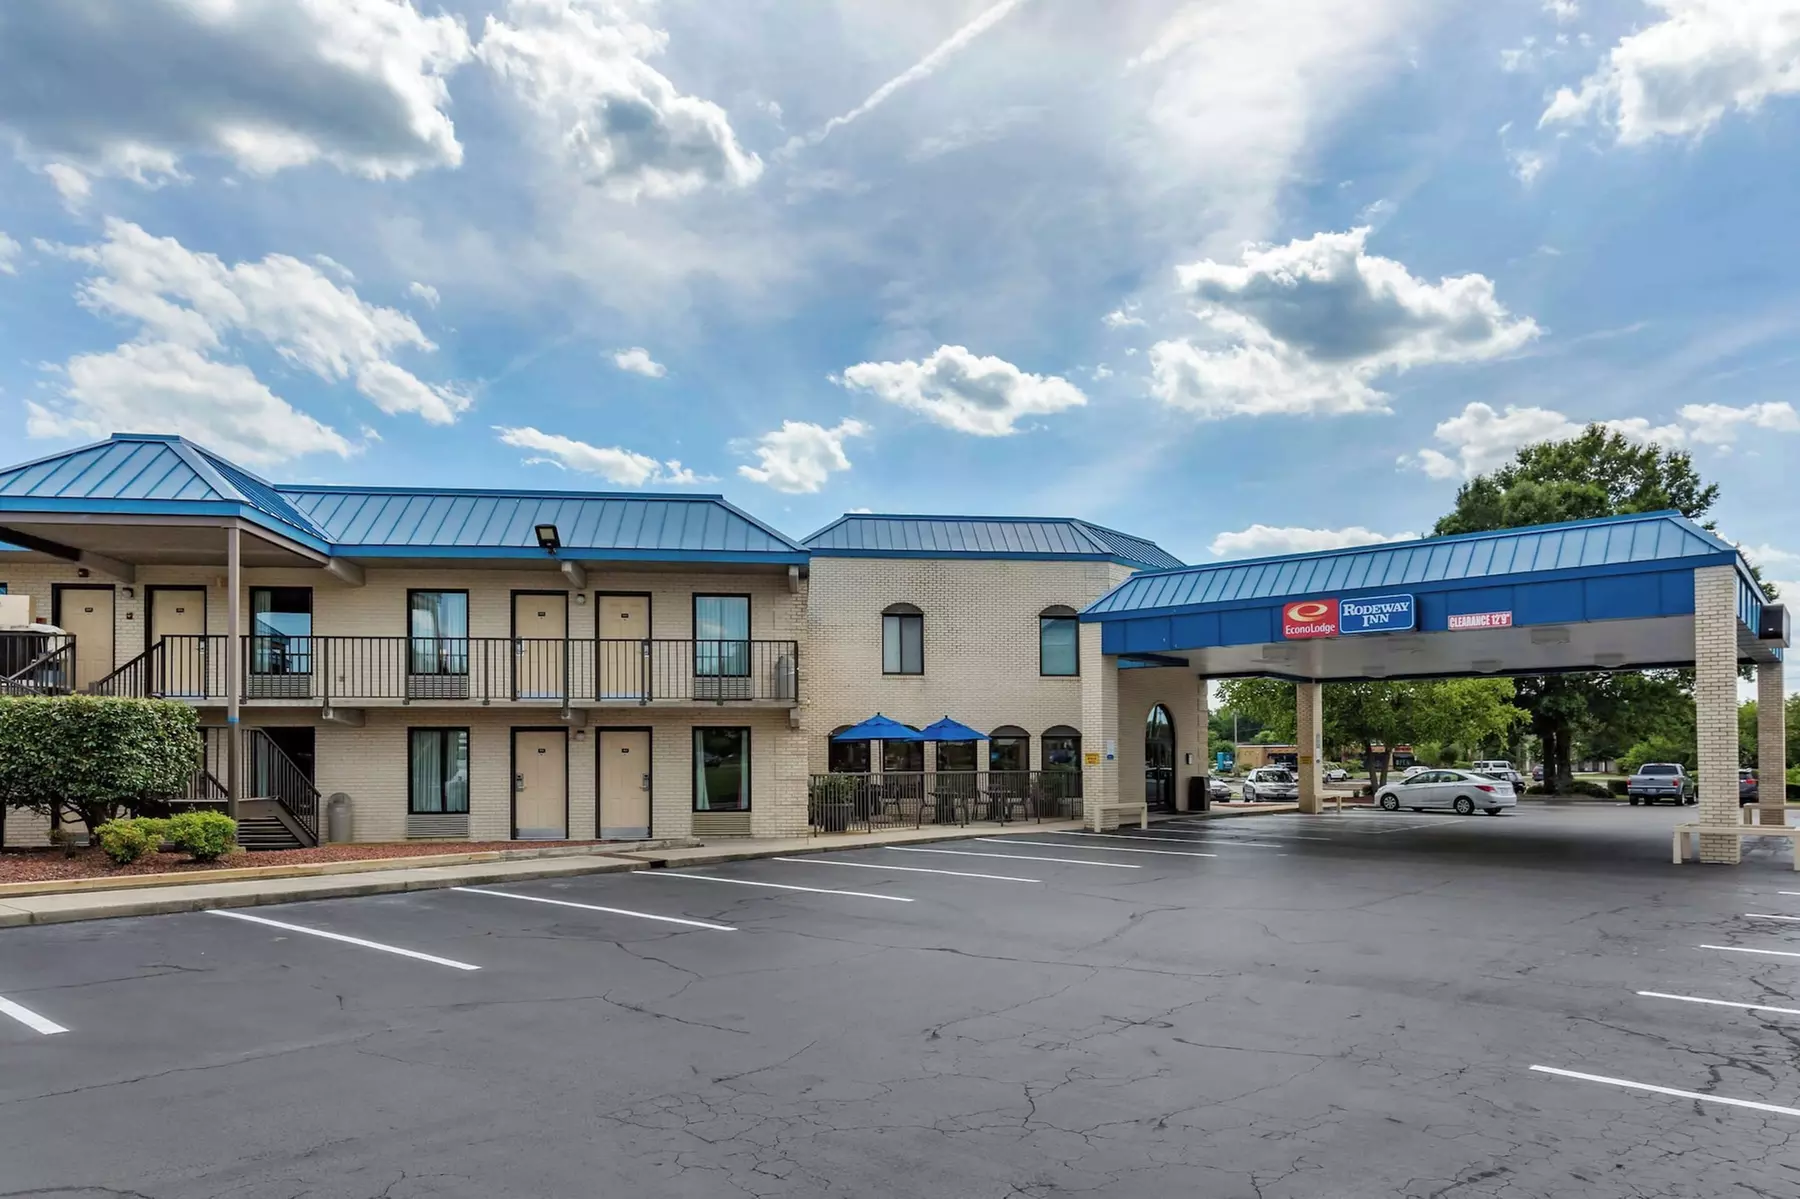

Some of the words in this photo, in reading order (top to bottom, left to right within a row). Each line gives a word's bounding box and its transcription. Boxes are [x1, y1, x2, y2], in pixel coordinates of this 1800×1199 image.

[1343, 602, 1410, 616] RODEWAY
[1362, 614, 1390, 627] INN
[1450, 614, 1491, 628] CLEARANCE
[1285, 623, 1336, 635] EconoLodge
